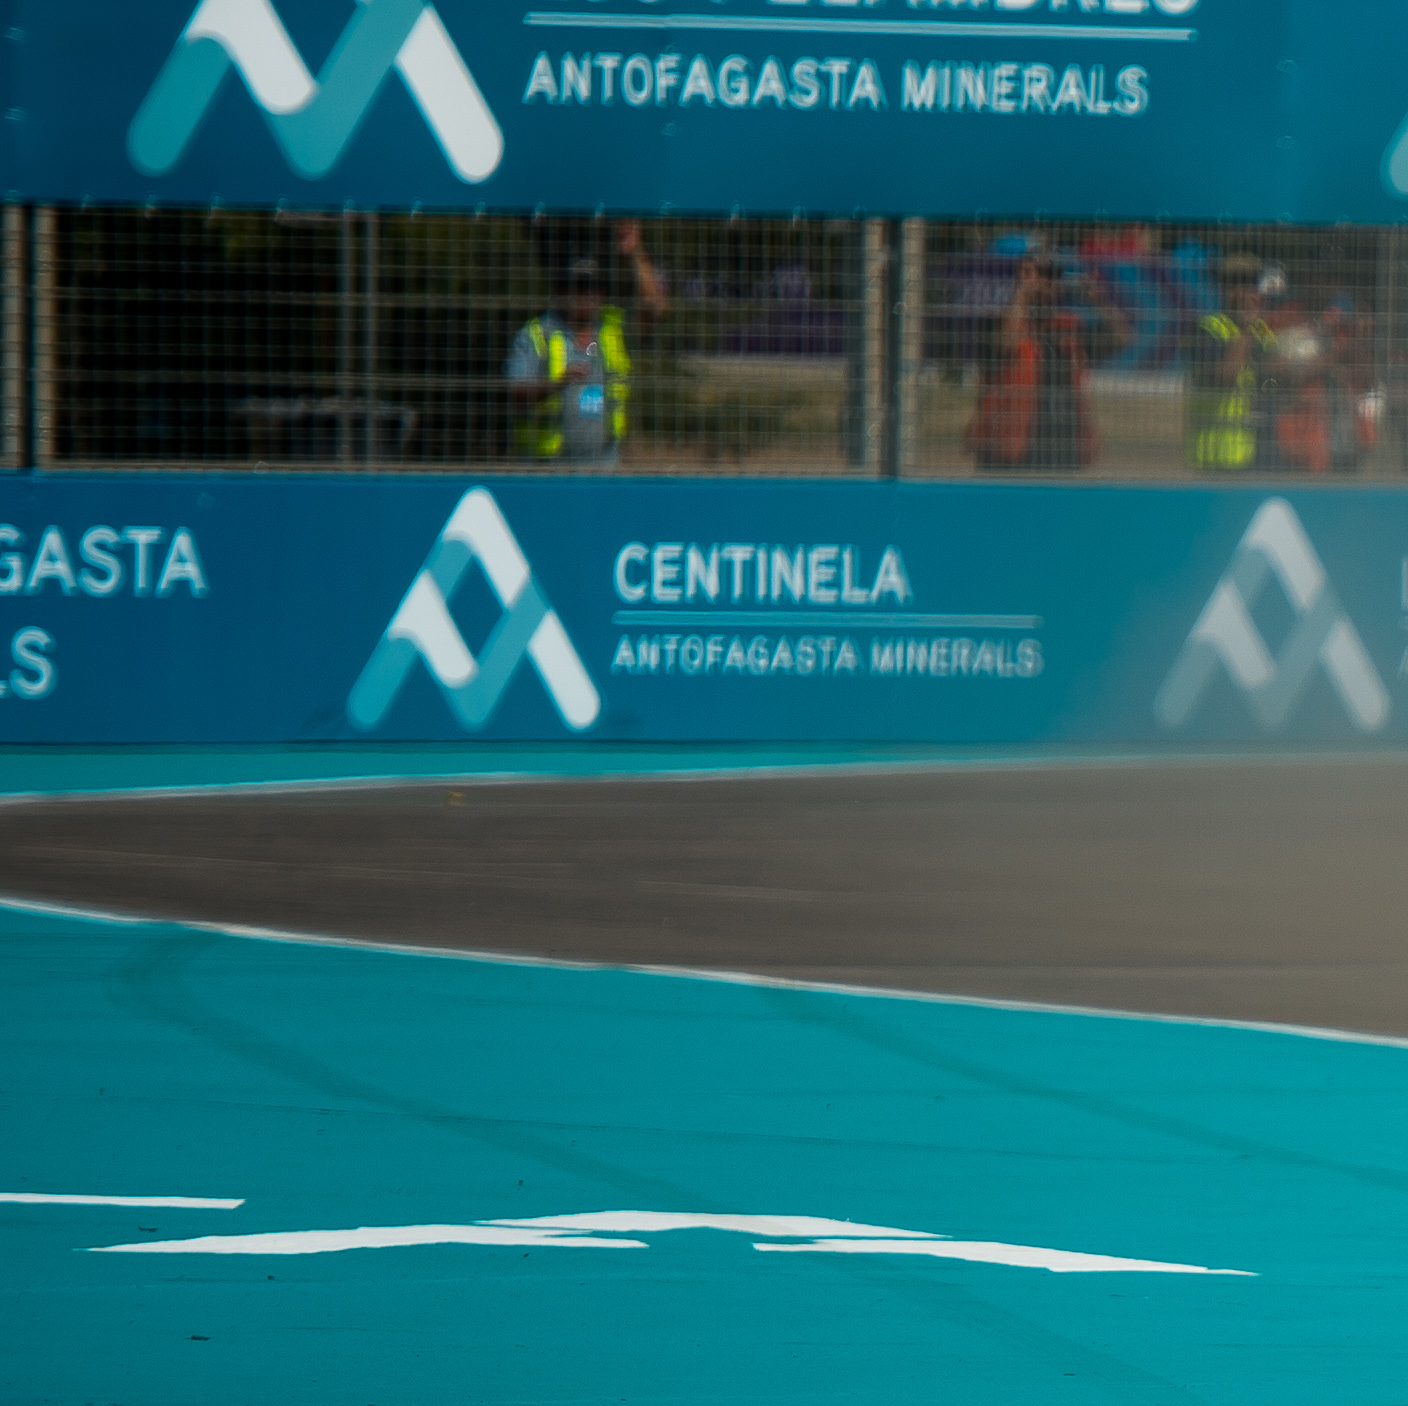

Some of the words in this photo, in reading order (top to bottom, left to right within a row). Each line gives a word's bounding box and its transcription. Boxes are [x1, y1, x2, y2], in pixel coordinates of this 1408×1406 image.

[524, 51, 886, 109] ANTOFAGASTA
[902, 59, 1150, 114] MINERALS
[613, 541, 912, 605] CENTINELA
[0, 626, 57, 699] S
[611, 635, 863, 676] ANTOFAGASTA
[871, 637, 1044, 677] MINERALS
